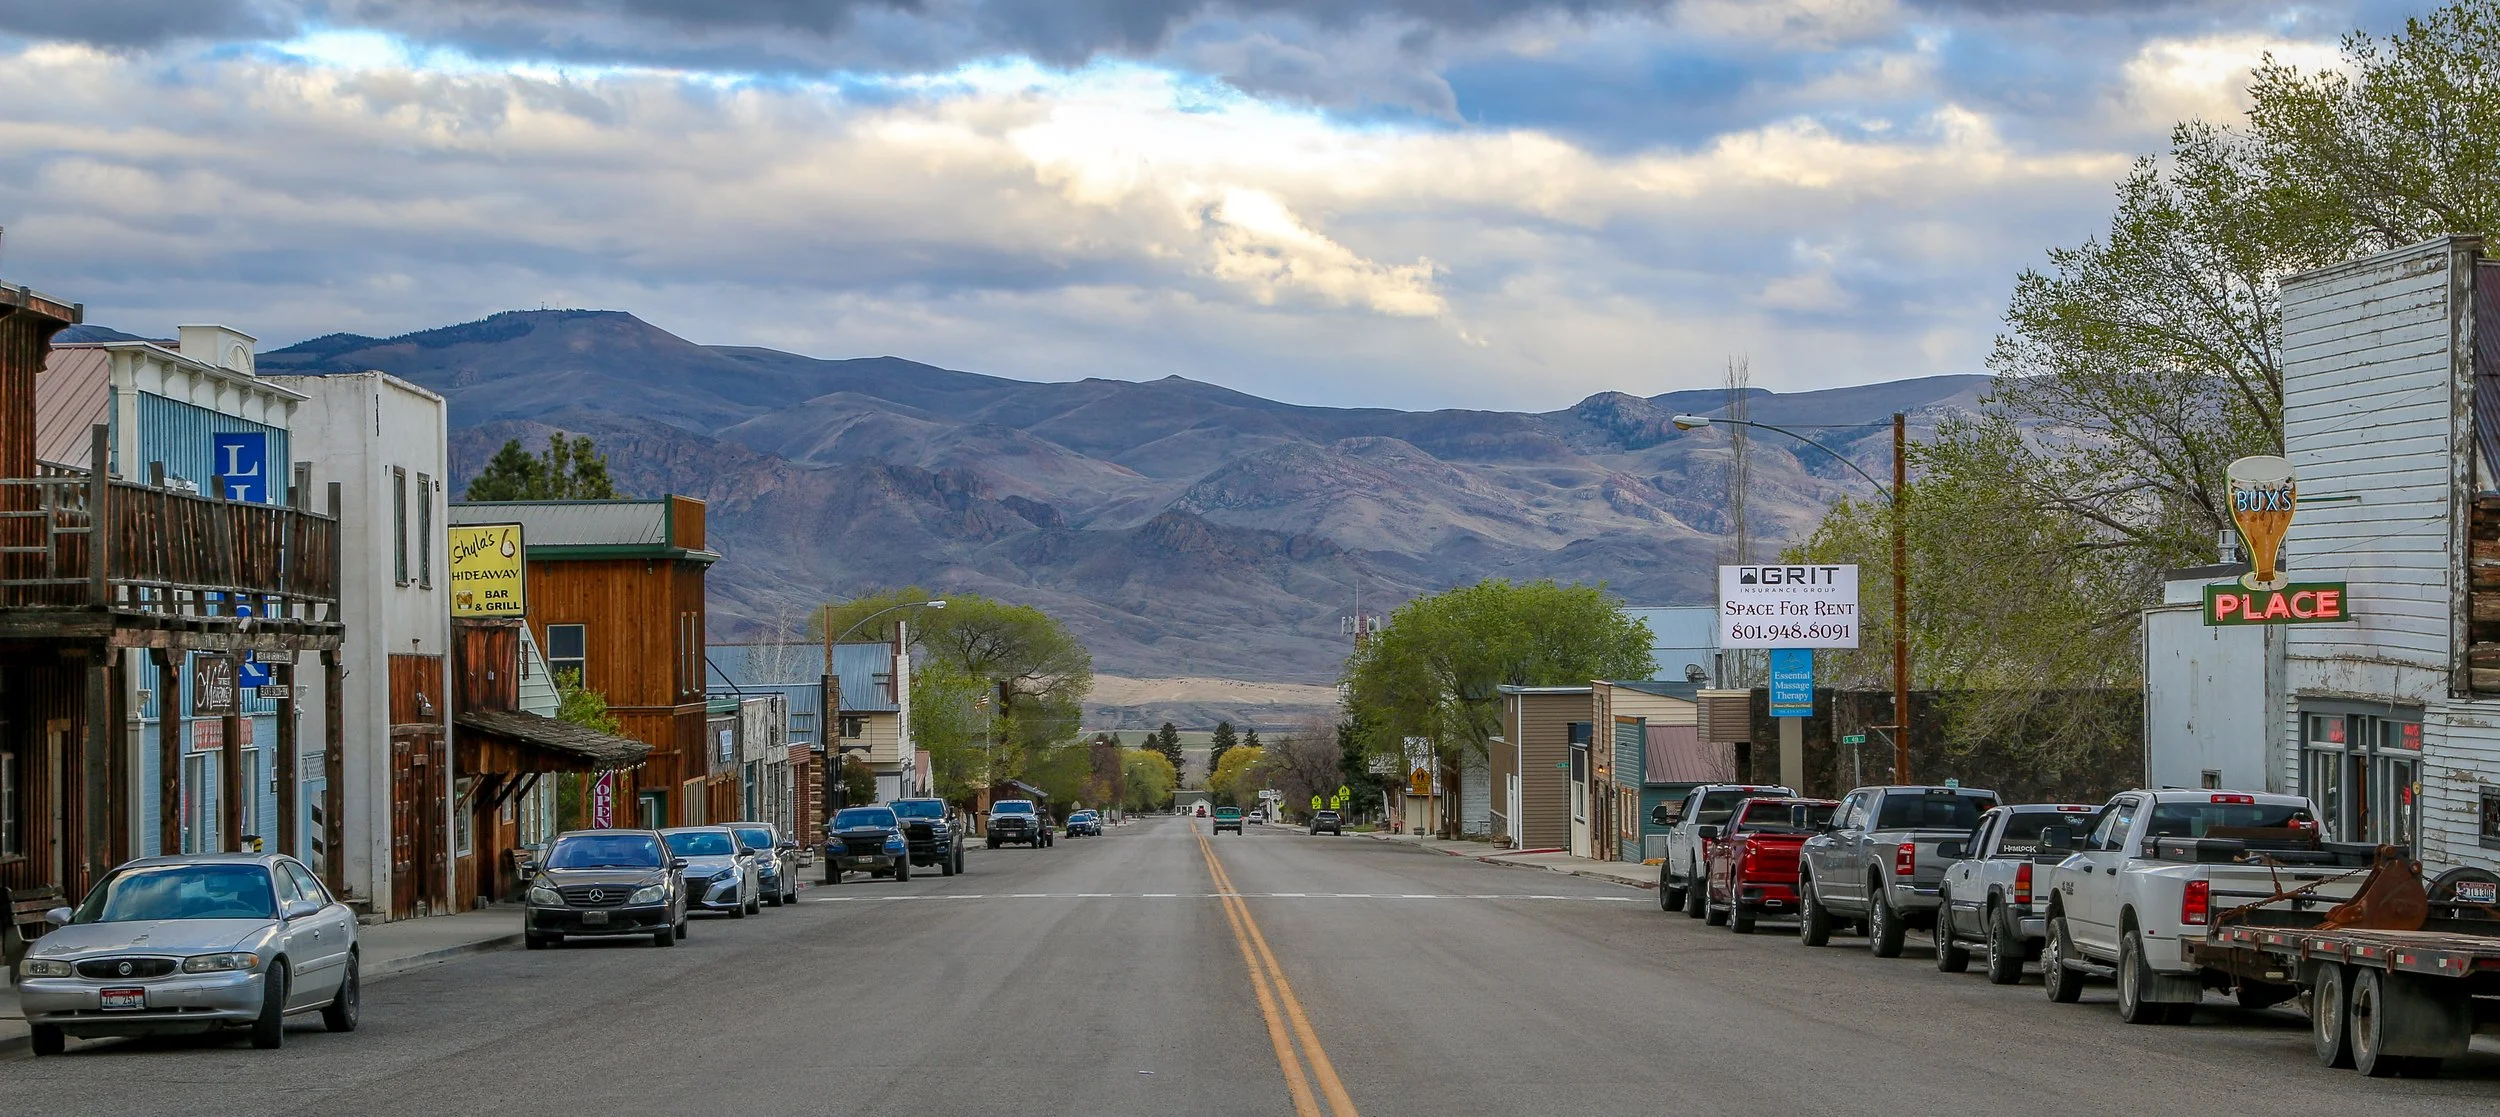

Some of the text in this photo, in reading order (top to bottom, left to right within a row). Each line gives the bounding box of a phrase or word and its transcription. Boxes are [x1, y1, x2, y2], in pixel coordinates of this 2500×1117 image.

[2237, 490, 2291, 512] BUXS
[453, 530, 495, 564] Shyla's
[452, 569, 519, 581] HIDEAWAY
[1761, 567, 1839, 585] GRIT
[485, 590, 508, 599] BAR
[475, 602, 520, 612] & GRILL
[2215, 590, 2340, 621] PLACE
[1732, 621, 1849, 641] 801.948.8091
[1774, 671, 1810, 680] Essential
[1775, 681, 1810, 691] Massage
[1776, 691, 1809, 701] Therapy
[596, 784, 610, 828] OPEN
